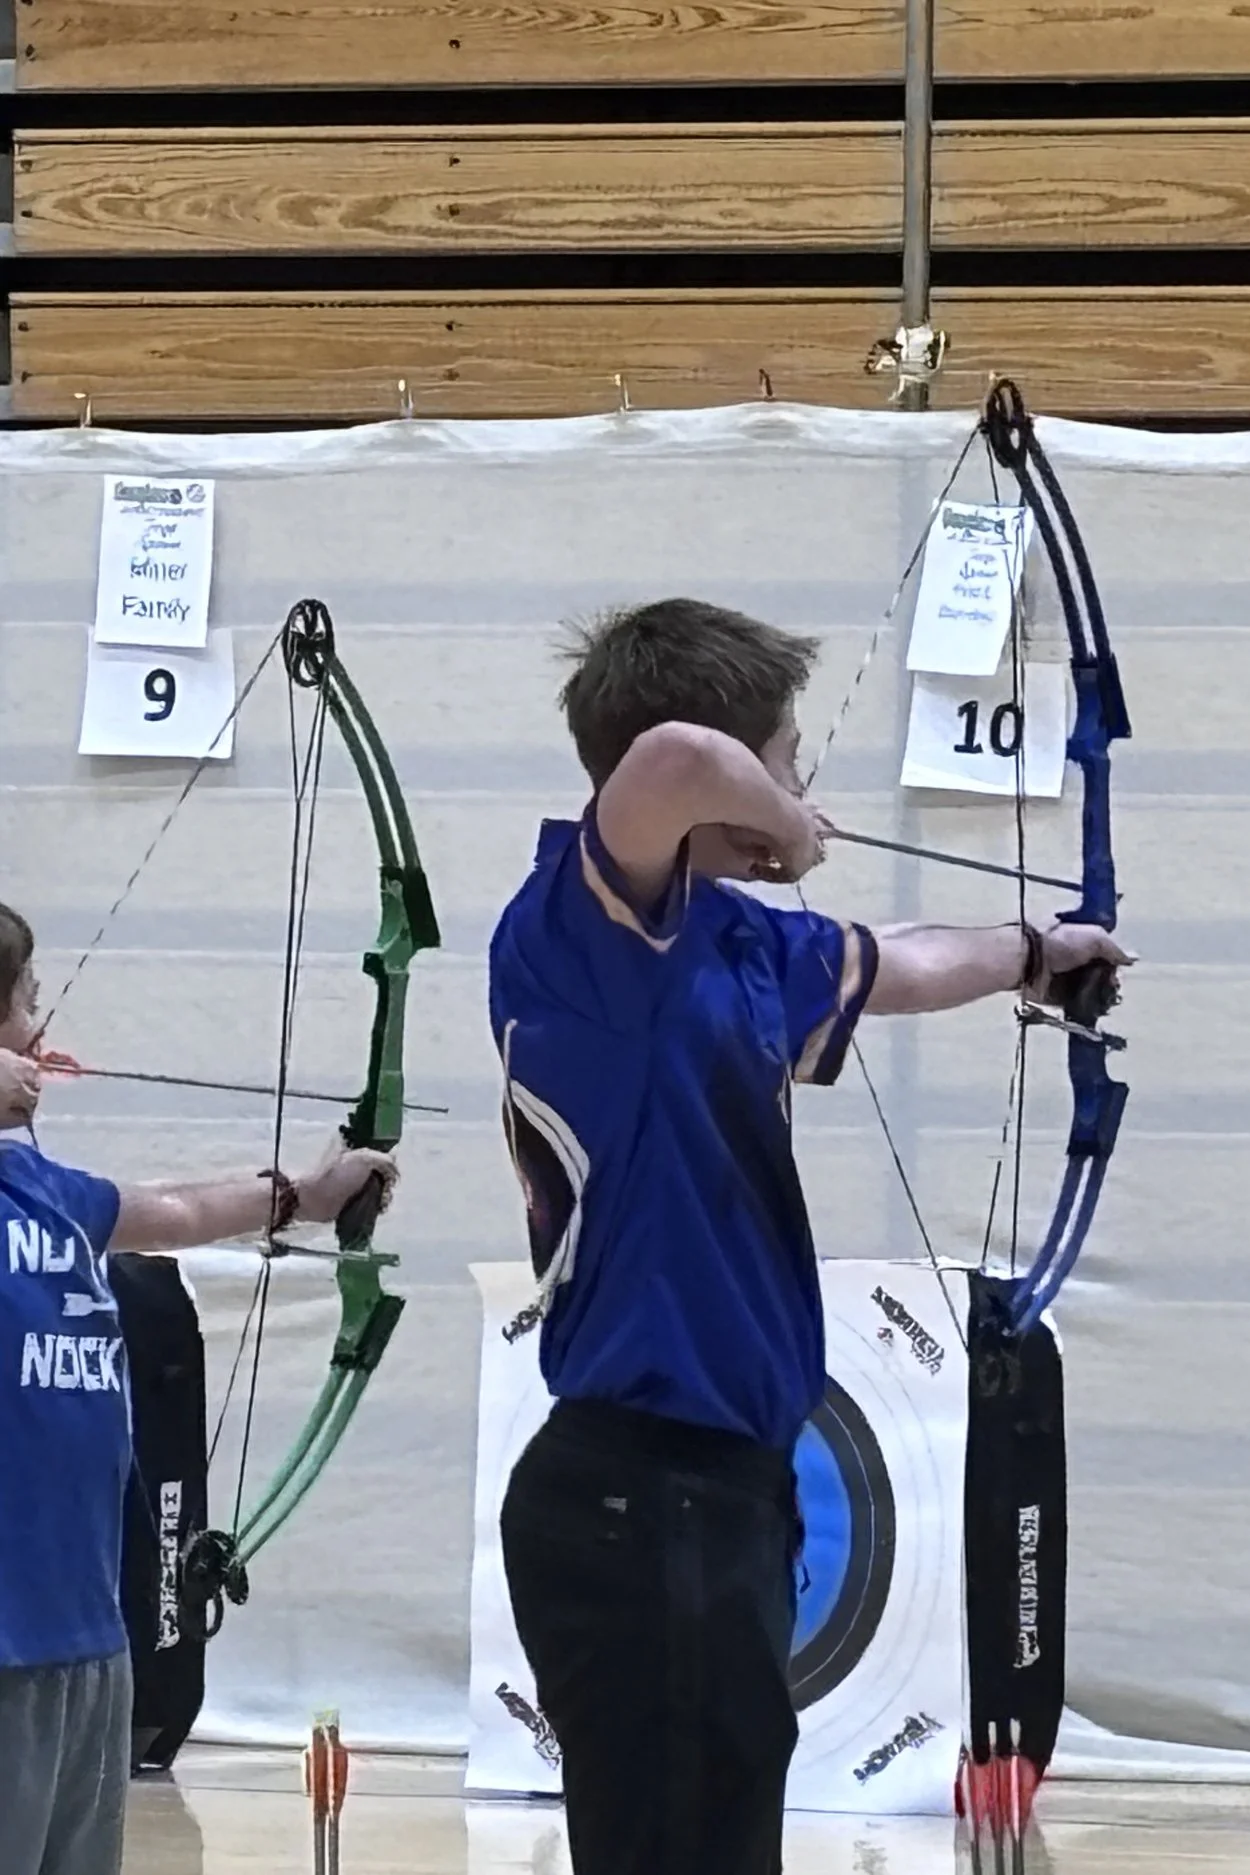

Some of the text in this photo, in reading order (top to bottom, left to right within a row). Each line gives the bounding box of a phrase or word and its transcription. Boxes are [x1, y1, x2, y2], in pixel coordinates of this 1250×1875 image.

[143, 667, 177, 722] 9
[953, 700, 1025, 757] 10
[20, 1332, 124, 1393] NOCK
